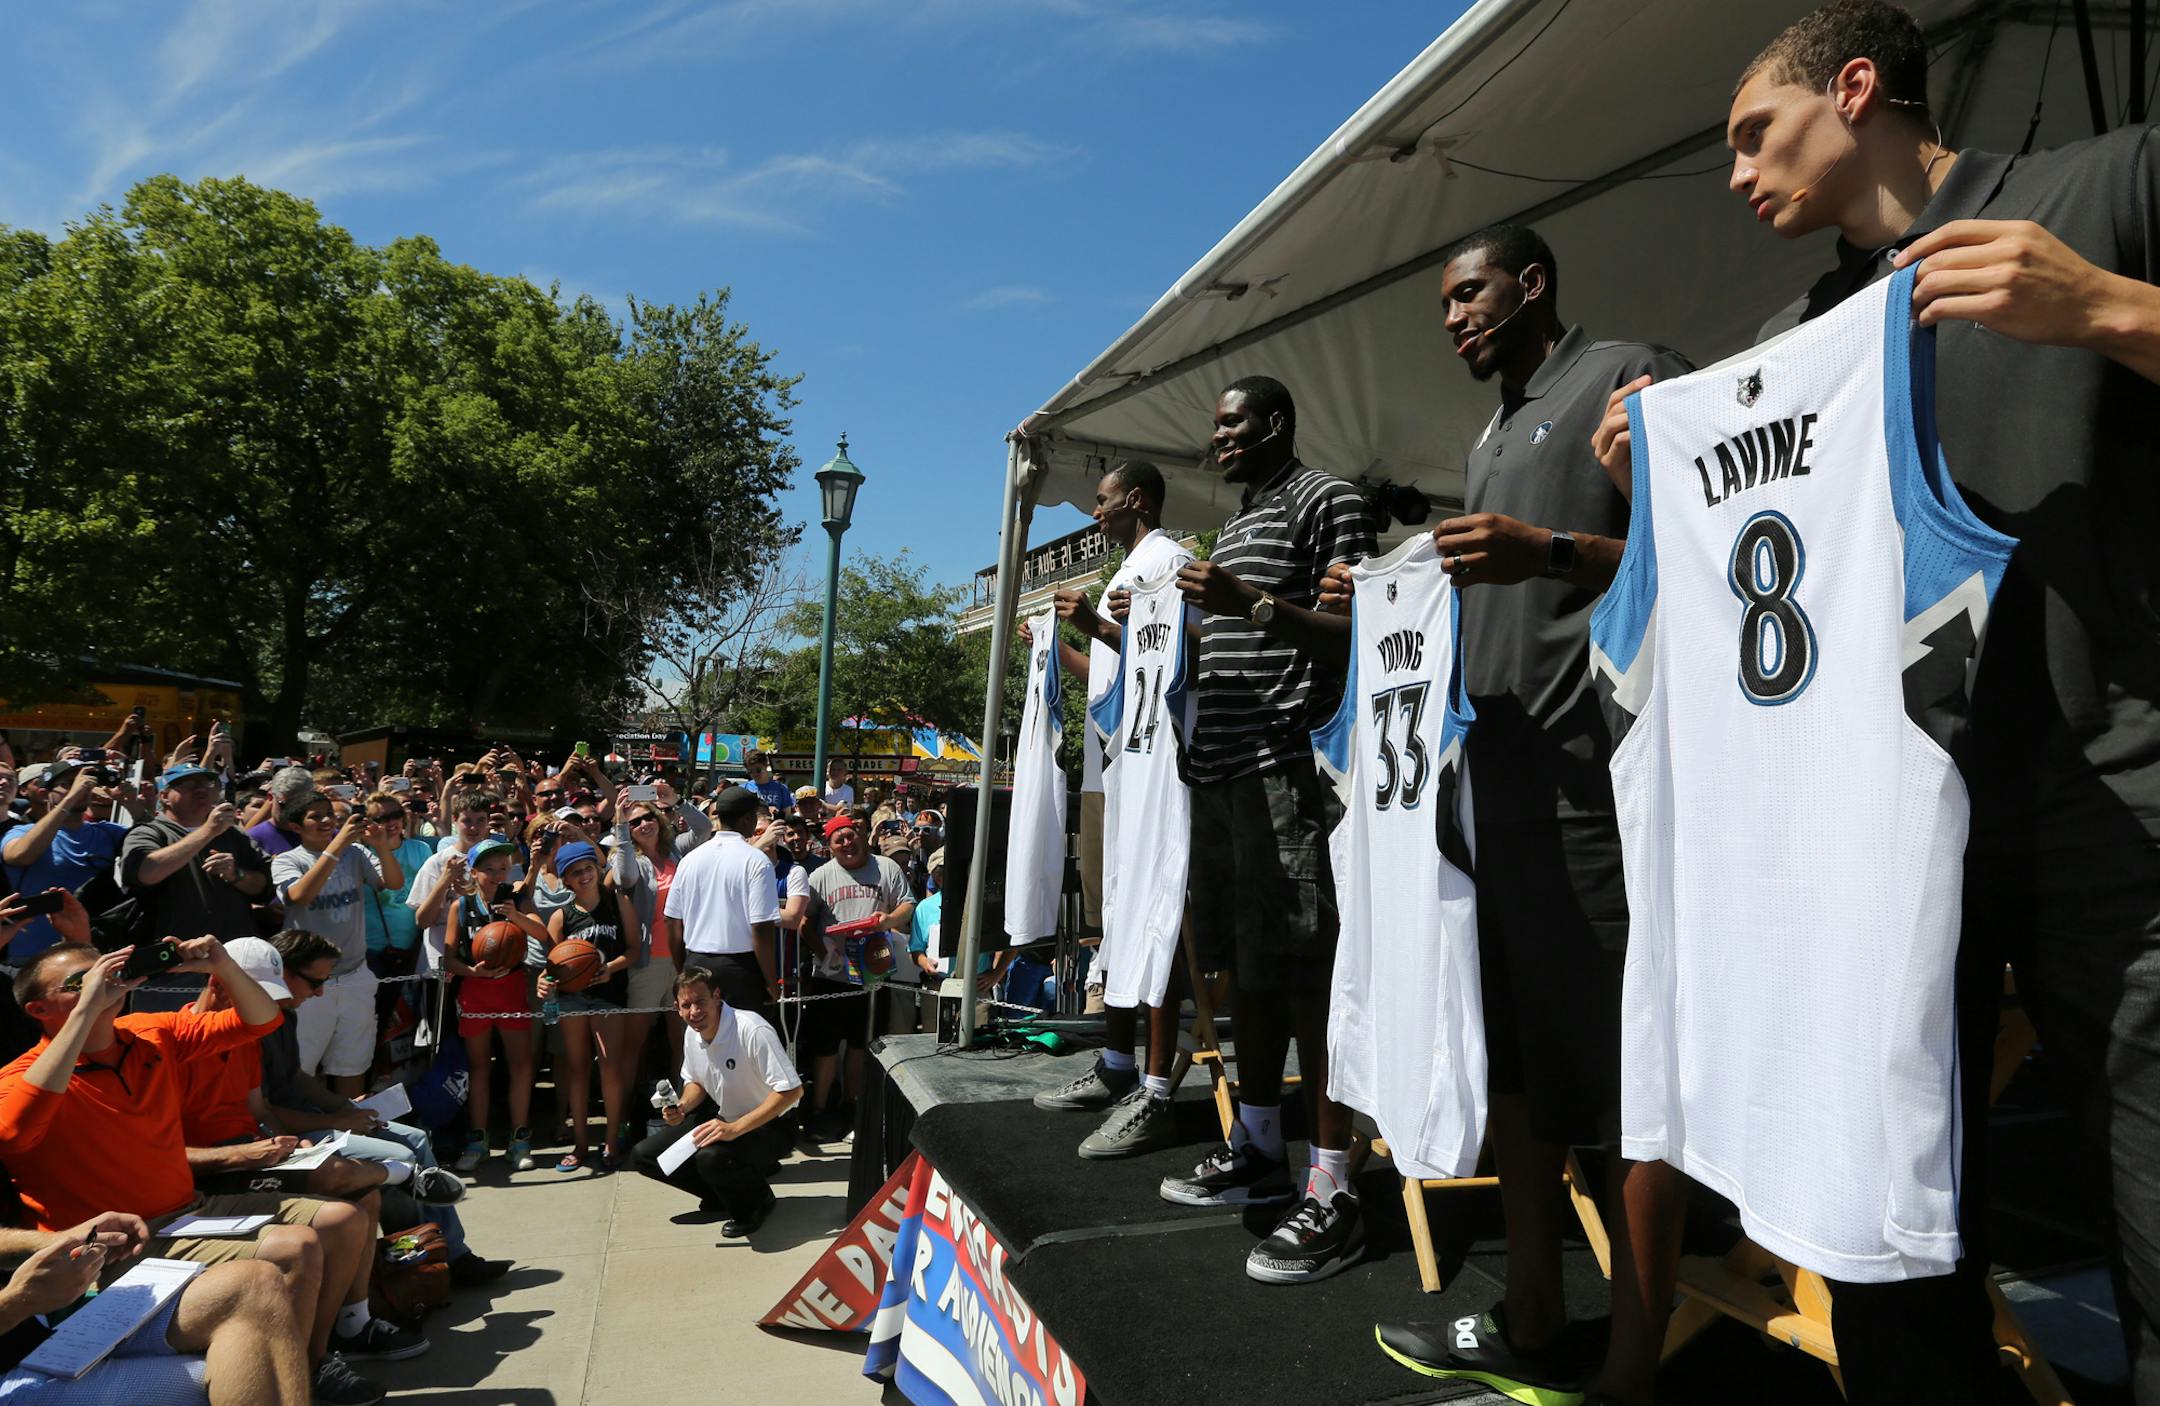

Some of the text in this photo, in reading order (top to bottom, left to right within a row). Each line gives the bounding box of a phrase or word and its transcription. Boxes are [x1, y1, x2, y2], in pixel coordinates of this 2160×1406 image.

[1694, 412, 1818, 508] LAVINE
[1038, 550, 1056, 577] AUG
[1061, 543, 1073, 568] 21
[1136, 623, 1172, 656] BENNETT
[1377, 630, 1425, 676] YOUNG
[1727, 509, 1819, 707] 8
[1124, 665, 1164, 755] 24
[1371, 680, 1432, 812] 33
